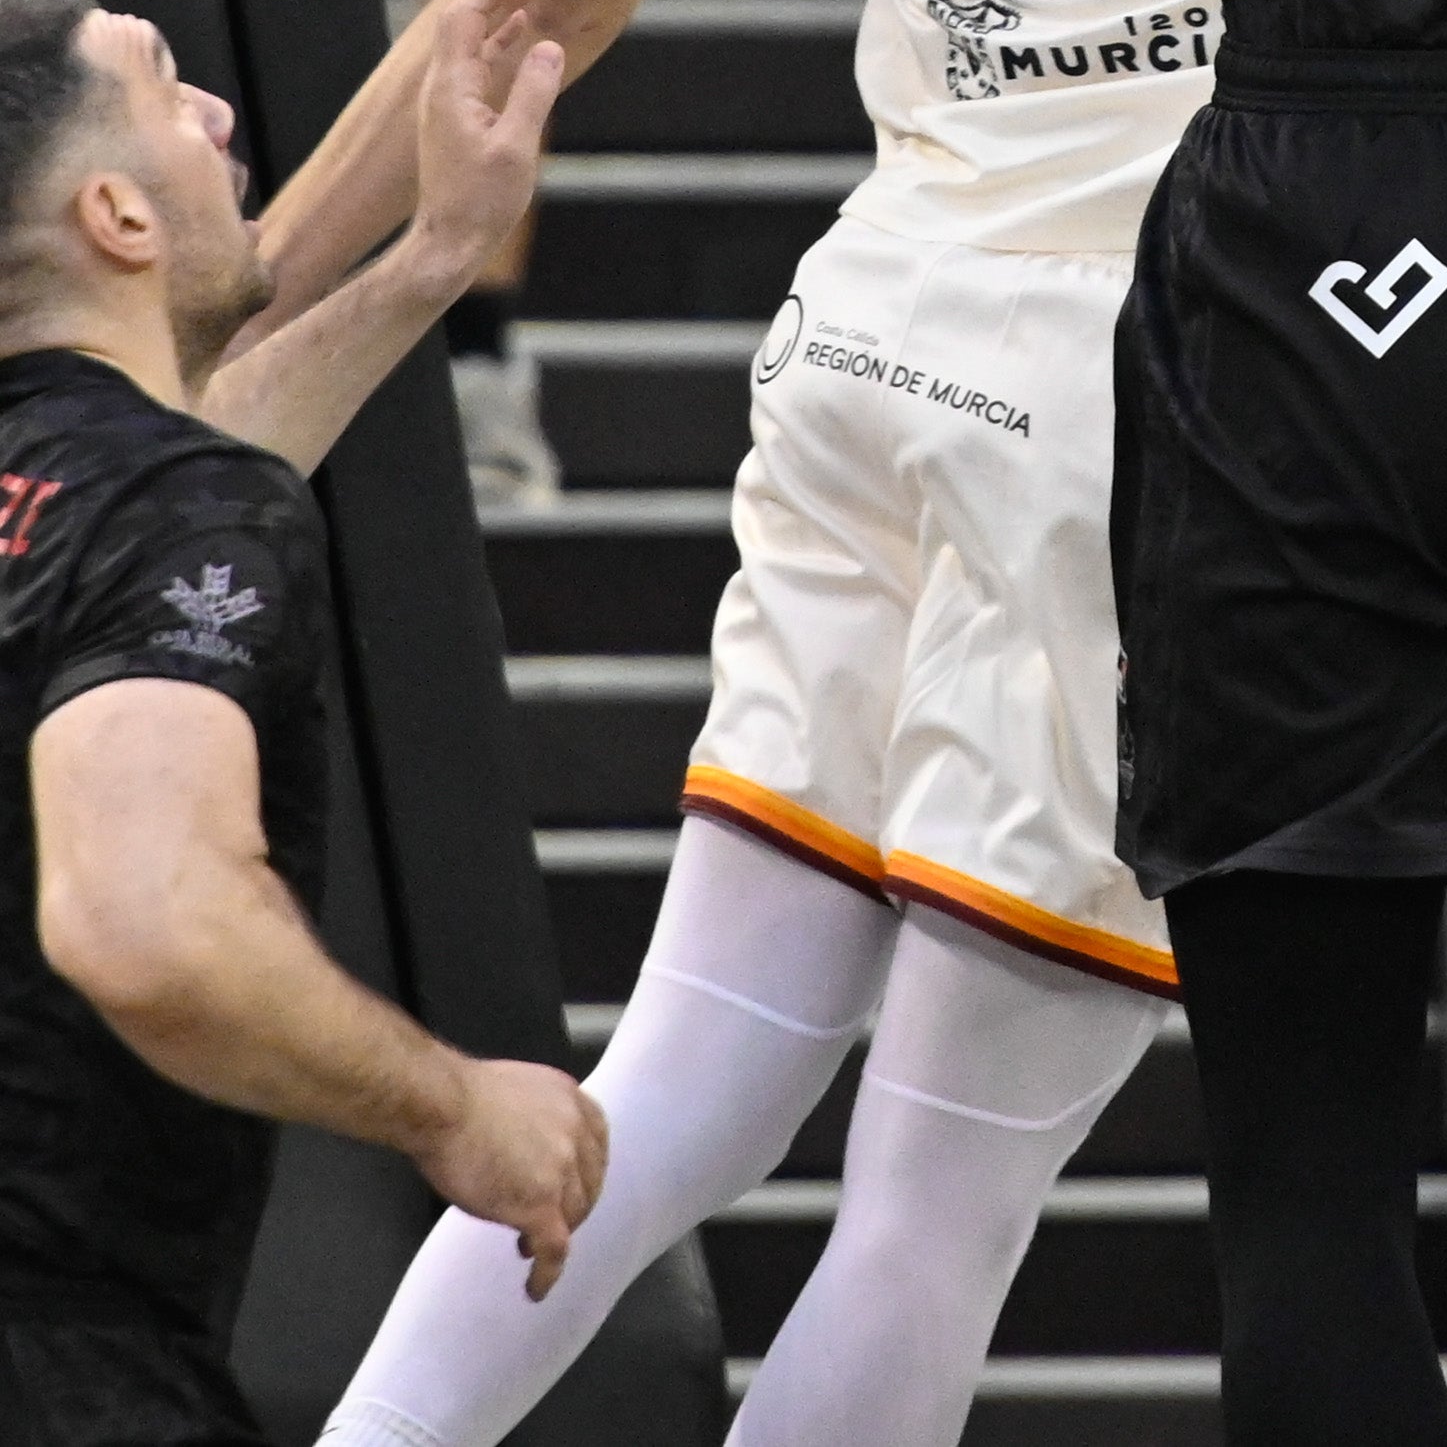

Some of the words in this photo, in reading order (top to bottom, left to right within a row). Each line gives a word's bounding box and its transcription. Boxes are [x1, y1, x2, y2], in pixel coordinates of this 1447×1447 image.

[1124, 7, 1209, 36] 120
[1000, 33, 1209, 80] MURCI
[803, 341, 889, 383] REGIÓN
[890, 364, 927, 395] DE
[926, 378, 1031, 438] MURCIA
